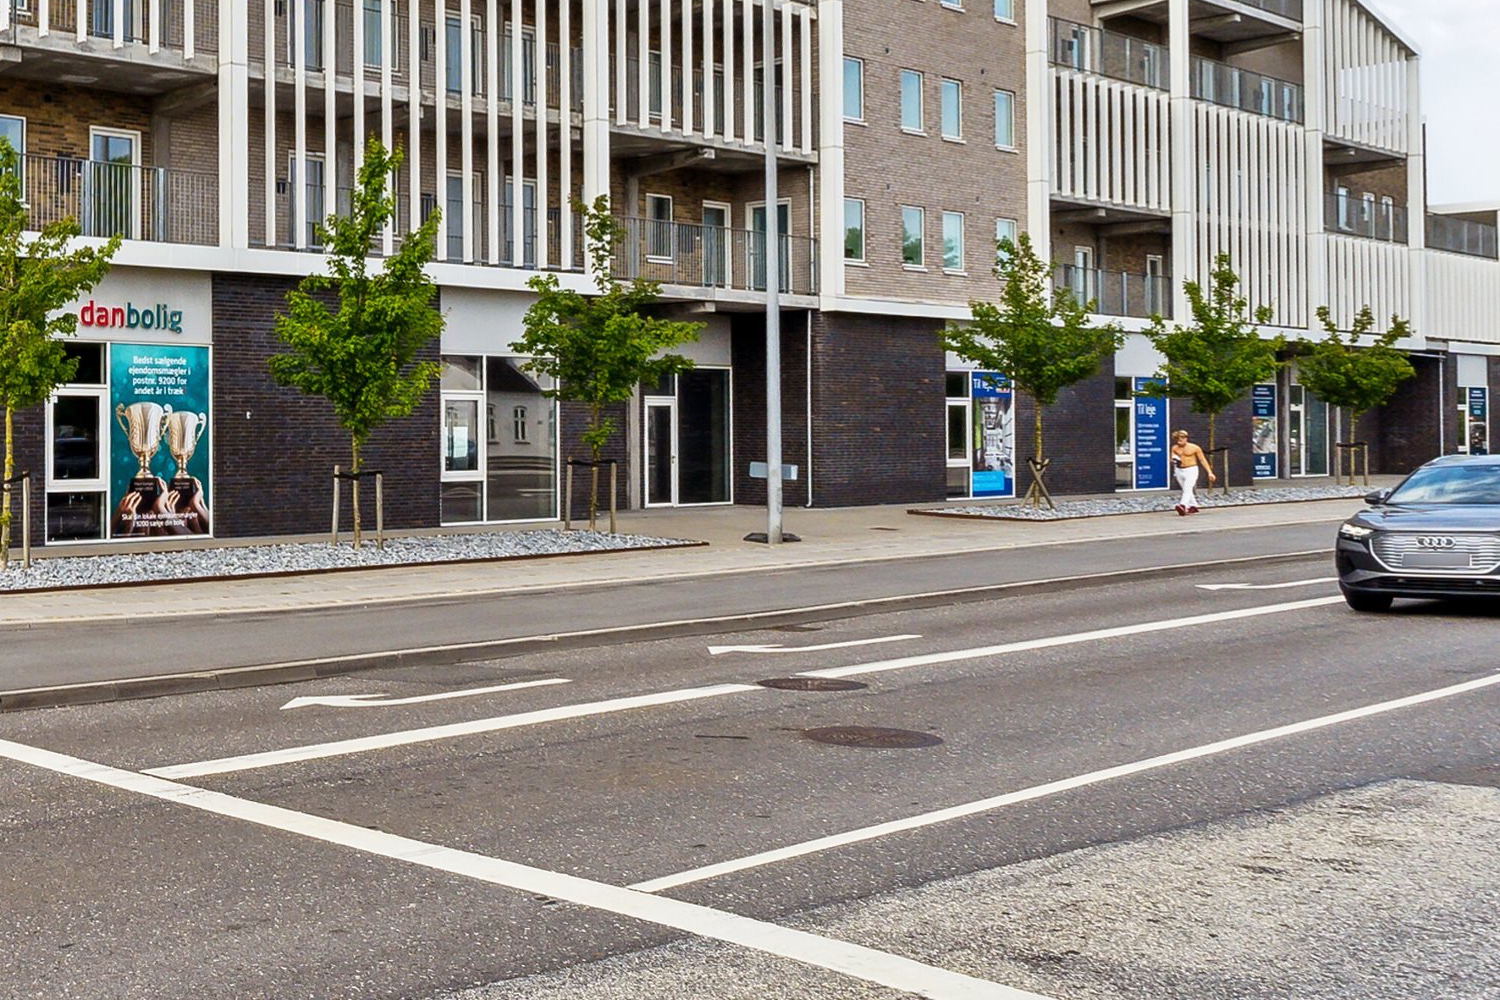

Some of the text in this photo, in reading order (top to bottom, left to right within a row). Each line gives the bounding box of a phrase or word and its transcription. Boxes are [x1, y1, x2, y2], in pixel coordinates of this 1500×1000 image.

[80, 300, 183, 334] danbolig
[132, 355, 153, 364] Bedst
[157, 376, 176, 385] 9200
[177, 376, 188, 385] for
[134, 386, 155, 395] andet
[1136, 403, 1145, 415] Til
